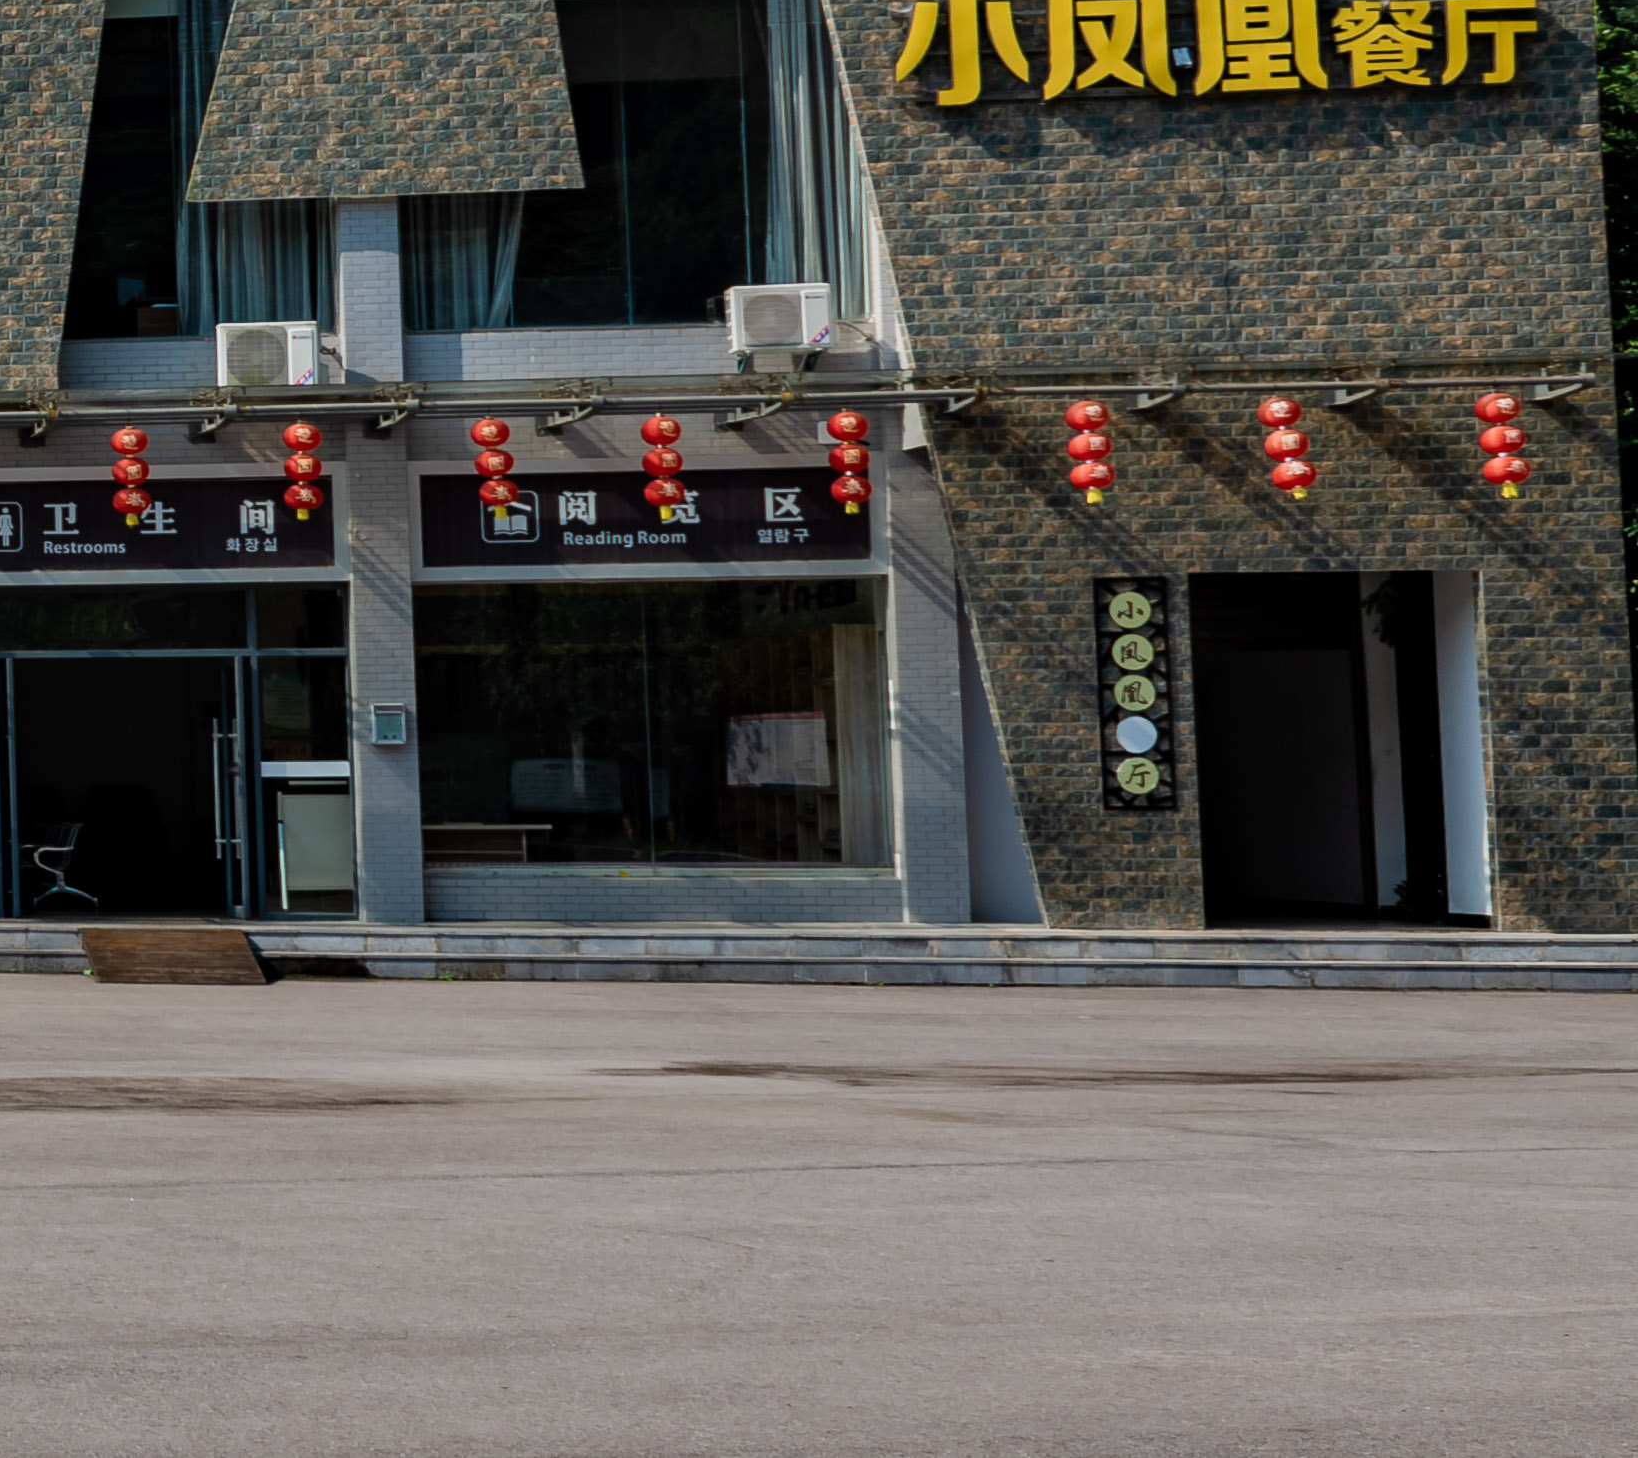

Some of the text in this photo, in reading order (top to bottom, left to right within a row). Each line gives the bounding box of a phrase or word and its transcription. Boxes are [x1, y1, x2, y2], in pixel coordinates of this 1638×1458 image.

[559, 487, 804, 526] 阅览区
[43, 499, 276, 536] 卫生间
[43, 541, 126, 555] Restrooms
[226, 537, 278, 553] 화장실
[564, 530, 687, 549] Reading Room
